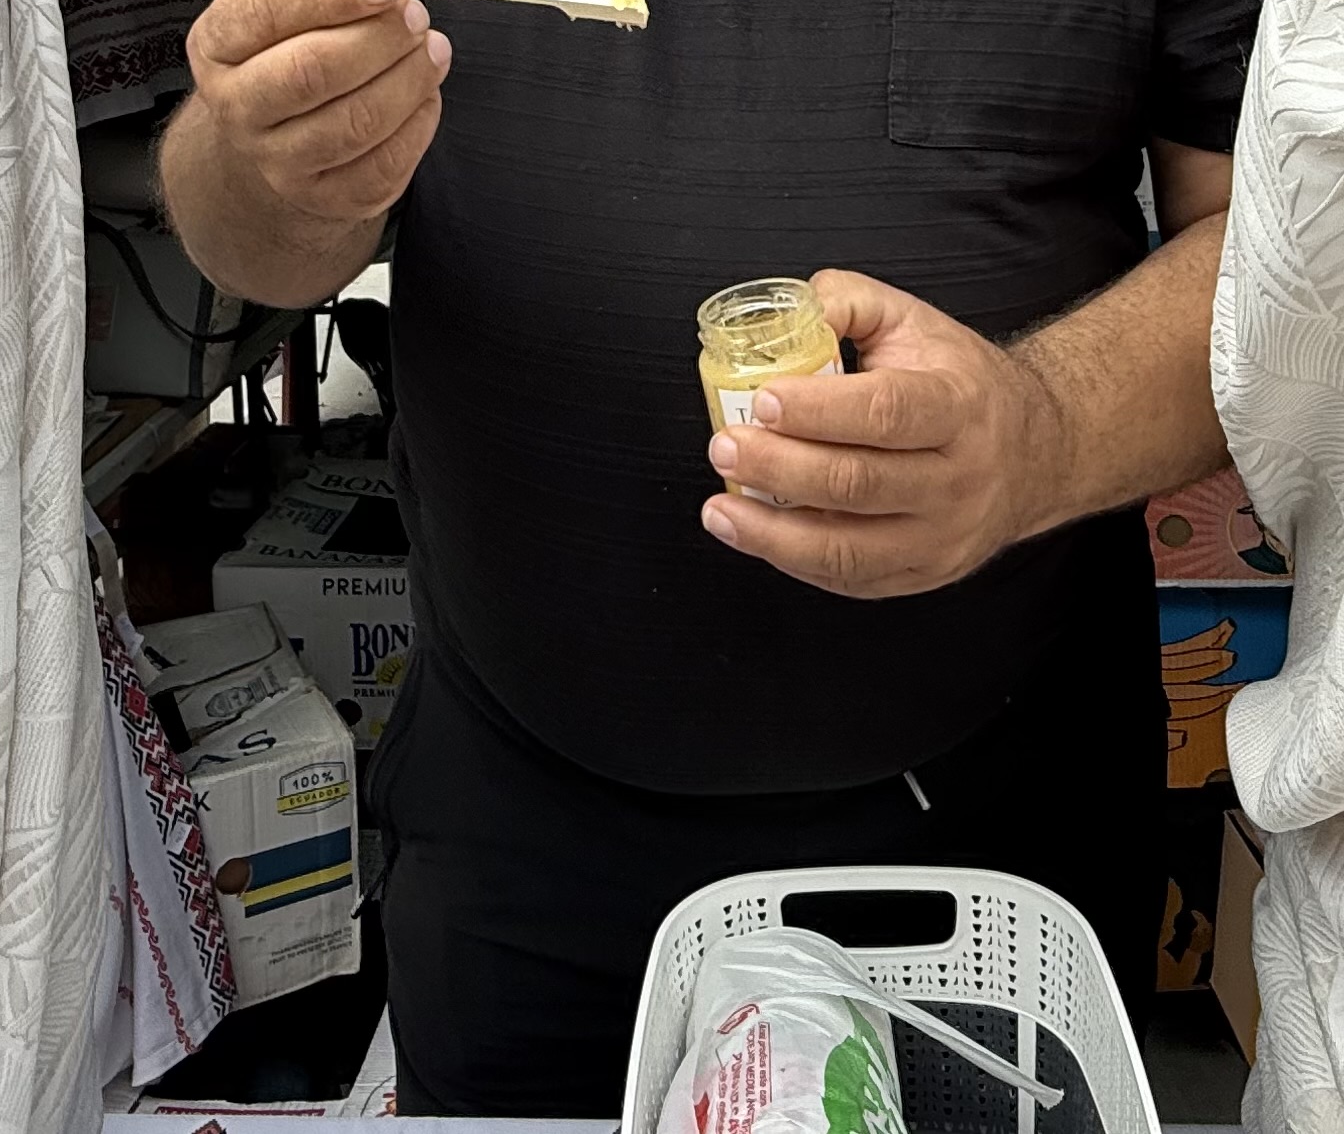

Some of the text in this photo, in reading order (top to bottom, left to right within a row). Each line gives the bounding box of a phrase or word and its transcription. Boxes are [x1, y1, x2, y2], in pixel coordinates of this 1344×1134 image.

[321, 474, 395, 494] BON
[322, 578, 406, 596] PREMIU
[350, 622, 415, 677] BON
[292, 770, 335, 790] 100%
